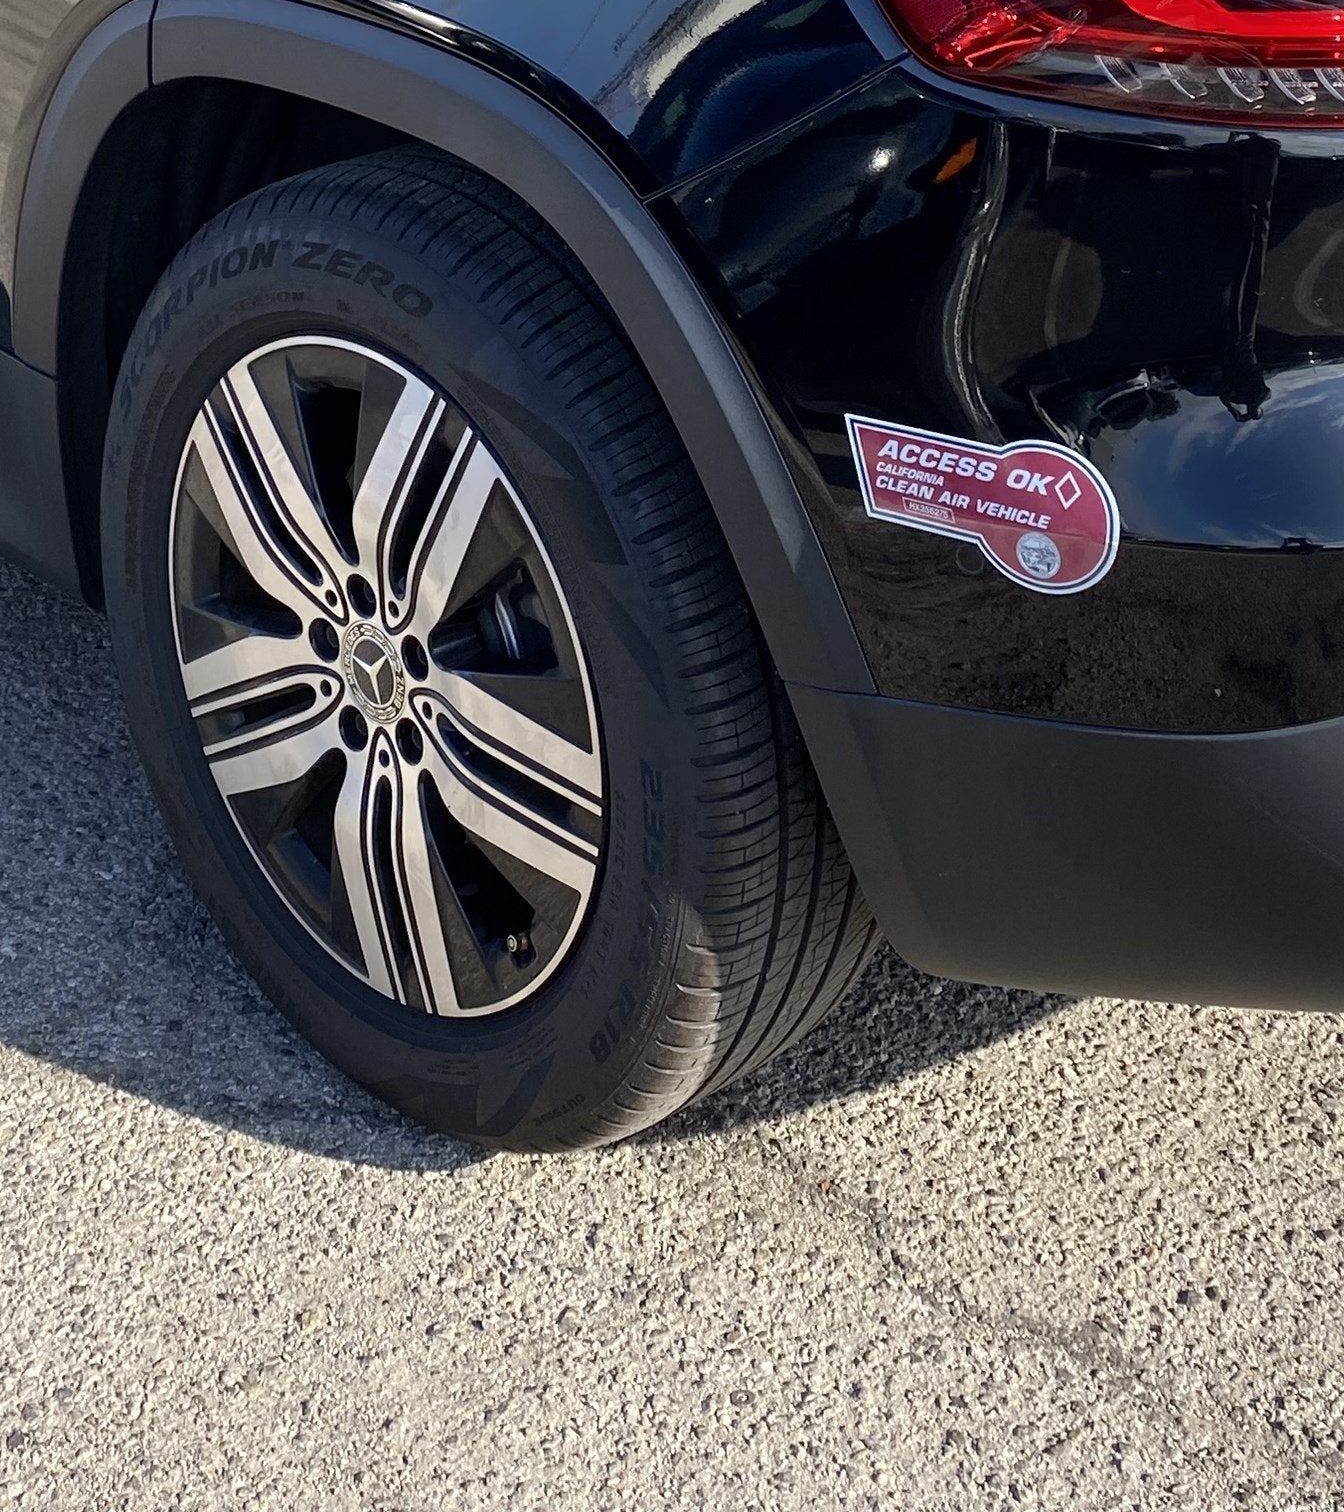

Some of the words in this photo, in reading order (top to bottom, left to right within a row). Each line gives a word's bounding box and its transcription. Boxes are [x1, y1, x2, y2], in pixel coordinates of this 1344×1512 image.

[292, 240, 434, 319] ZERO
[876, 462, 944, 487] CALIFORNIA
[877, 439, 997, 483] ACCESS
[1006, 468, 1056, 496] OK
[876, 474, 934, 500] CLEAN
[938, 490, 969, 510] AIR
[976, 498, 1051, 530] VEHICLE
